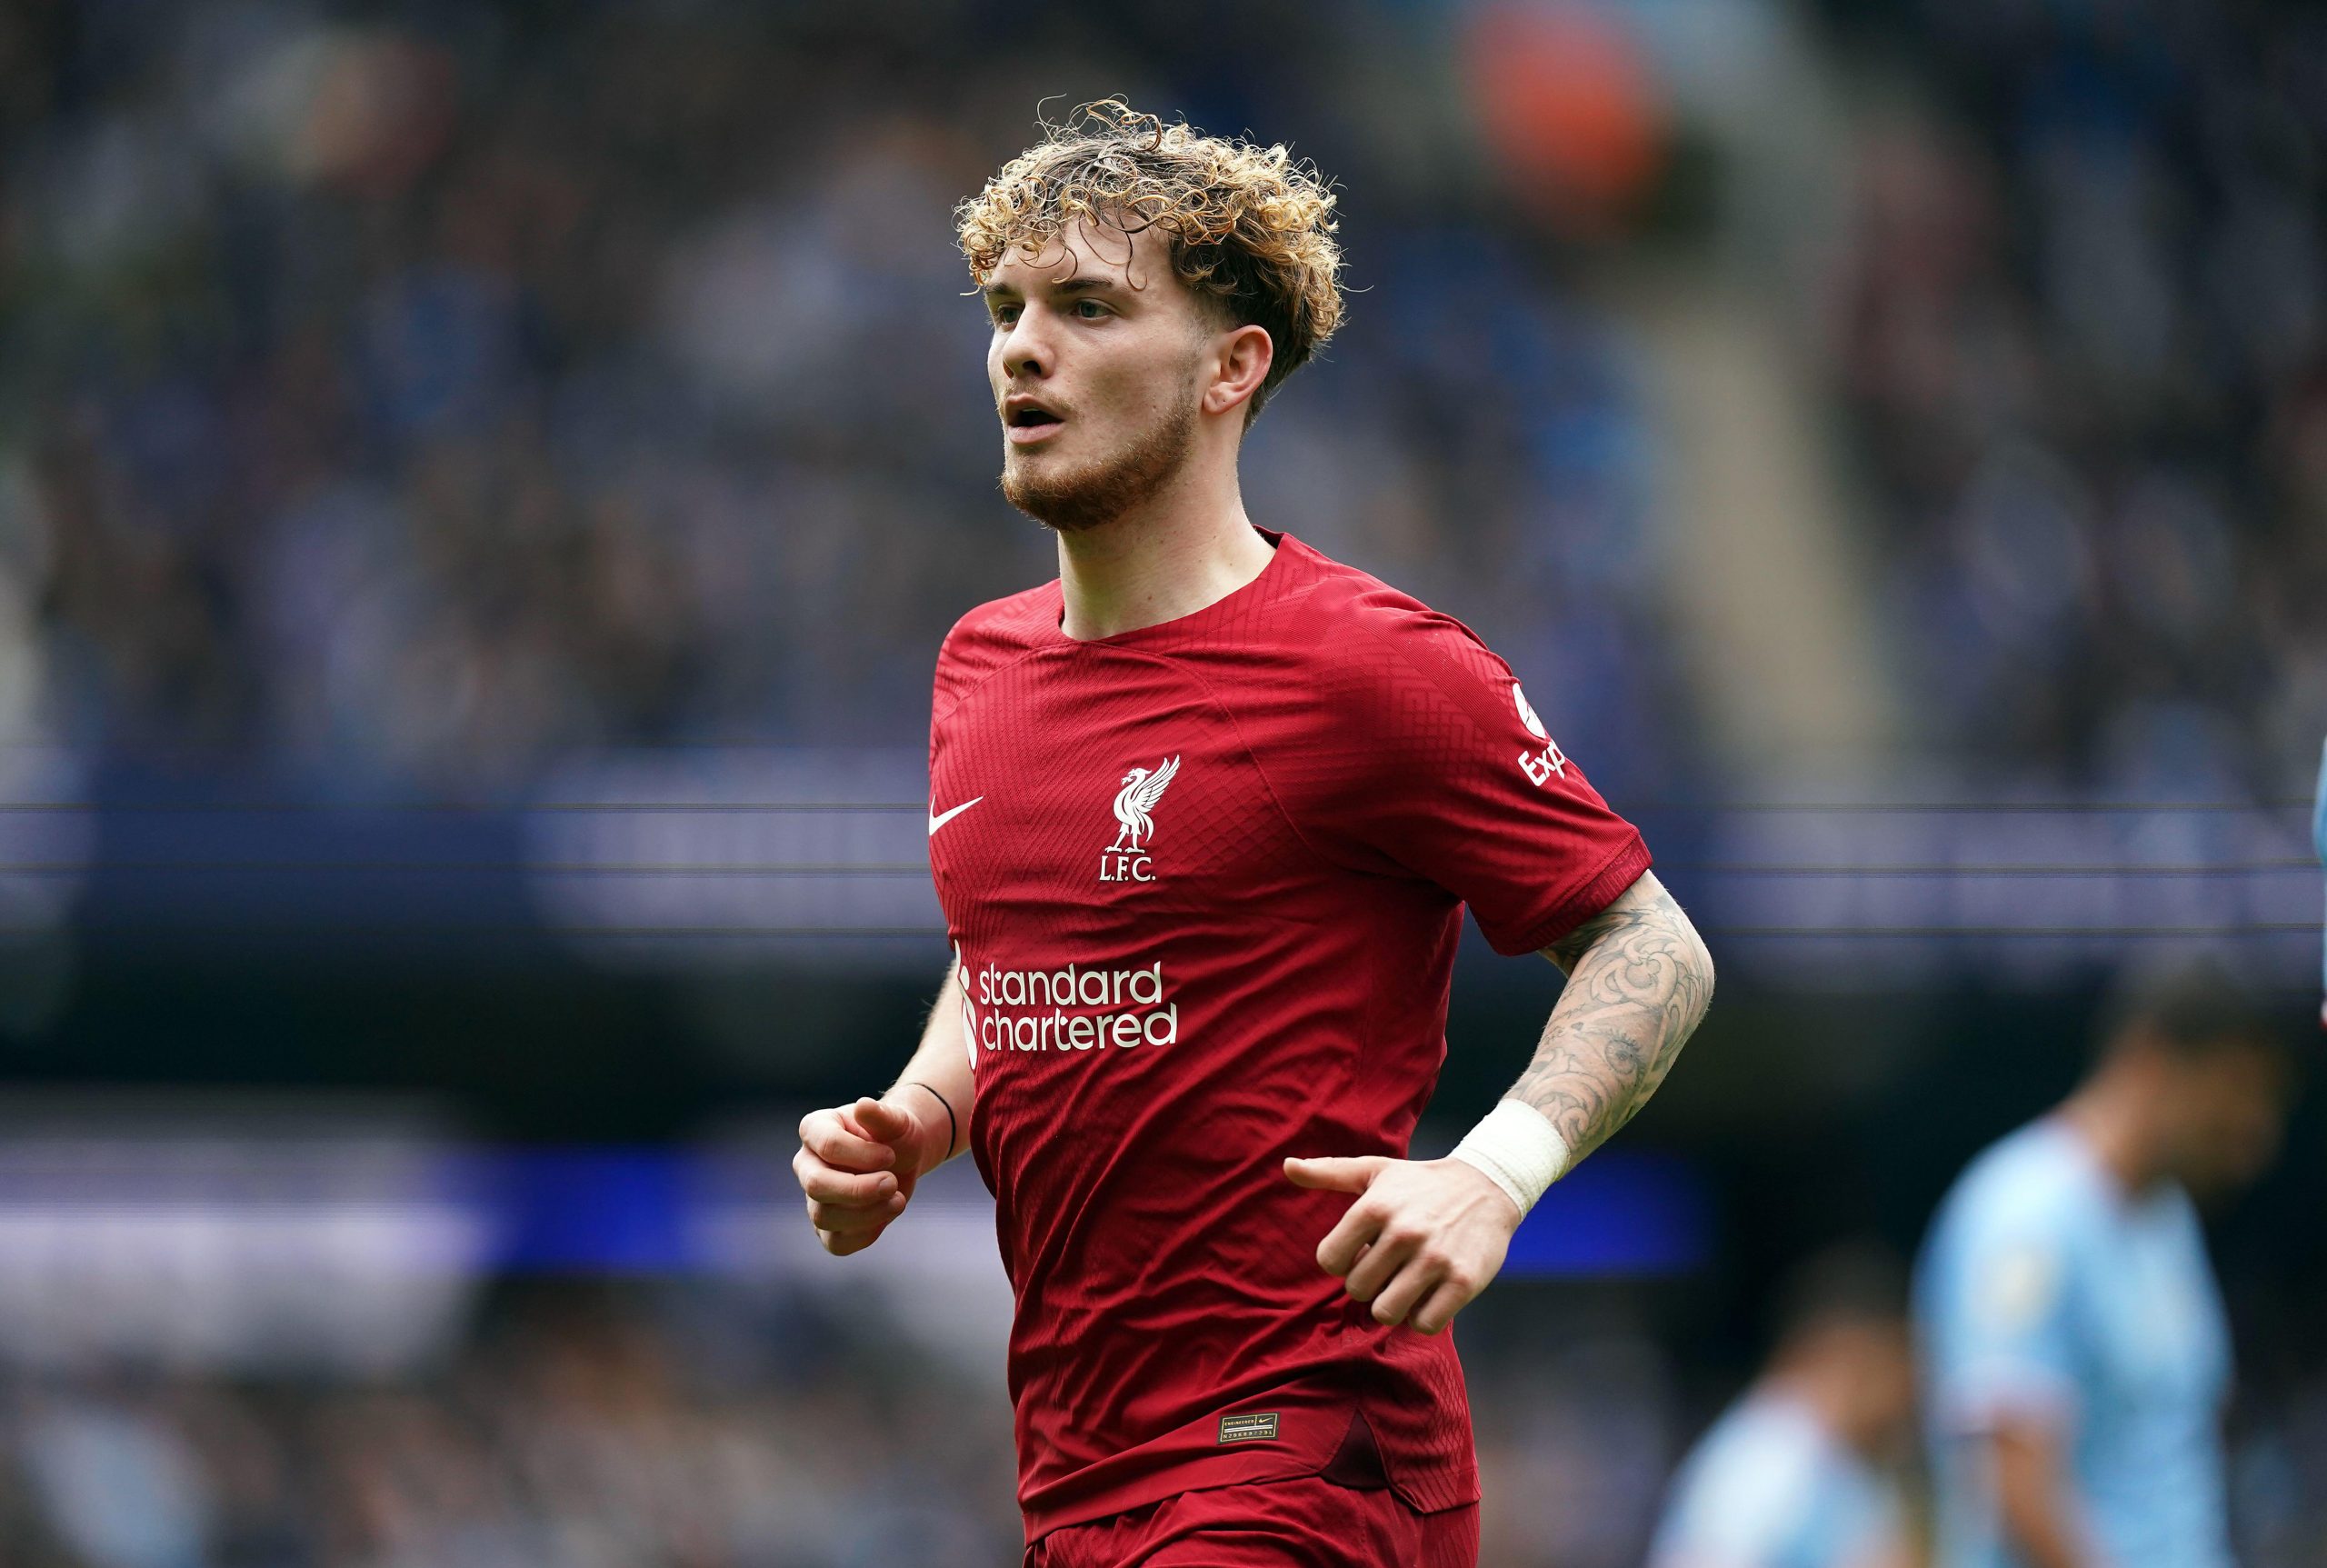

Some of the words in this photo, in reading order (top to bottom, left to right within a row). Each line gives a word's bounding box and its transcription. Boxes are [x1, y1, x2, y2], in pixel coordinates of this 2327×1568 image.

[1099, 854, 1156, 882] L.F.C.
[979, 960, 1163, 1006] standard
[982, 1002, 1178, 1052] chartered
